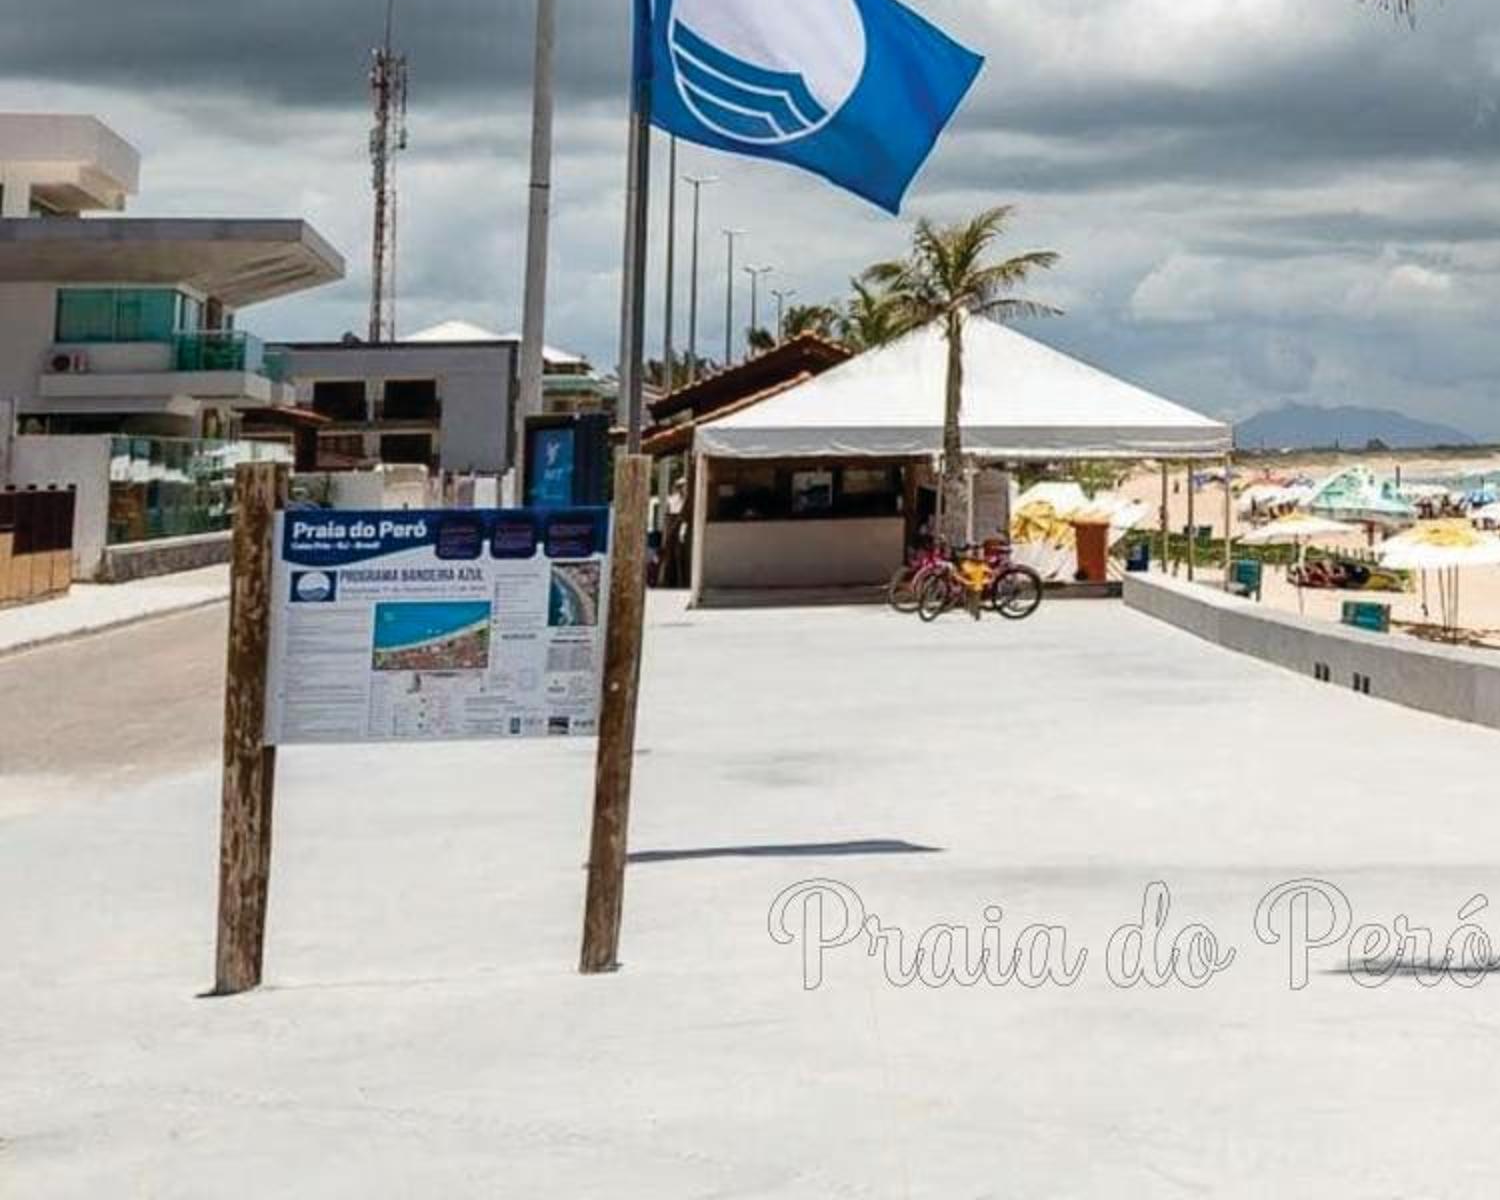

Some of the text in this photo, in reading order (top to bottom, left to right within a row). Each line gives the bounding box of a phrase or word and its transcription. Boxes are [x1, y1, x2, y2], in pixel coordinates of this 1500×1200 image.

[293, 518, 427, 538] Praia do Peró
[457, 567, 484, 581] AZUL
